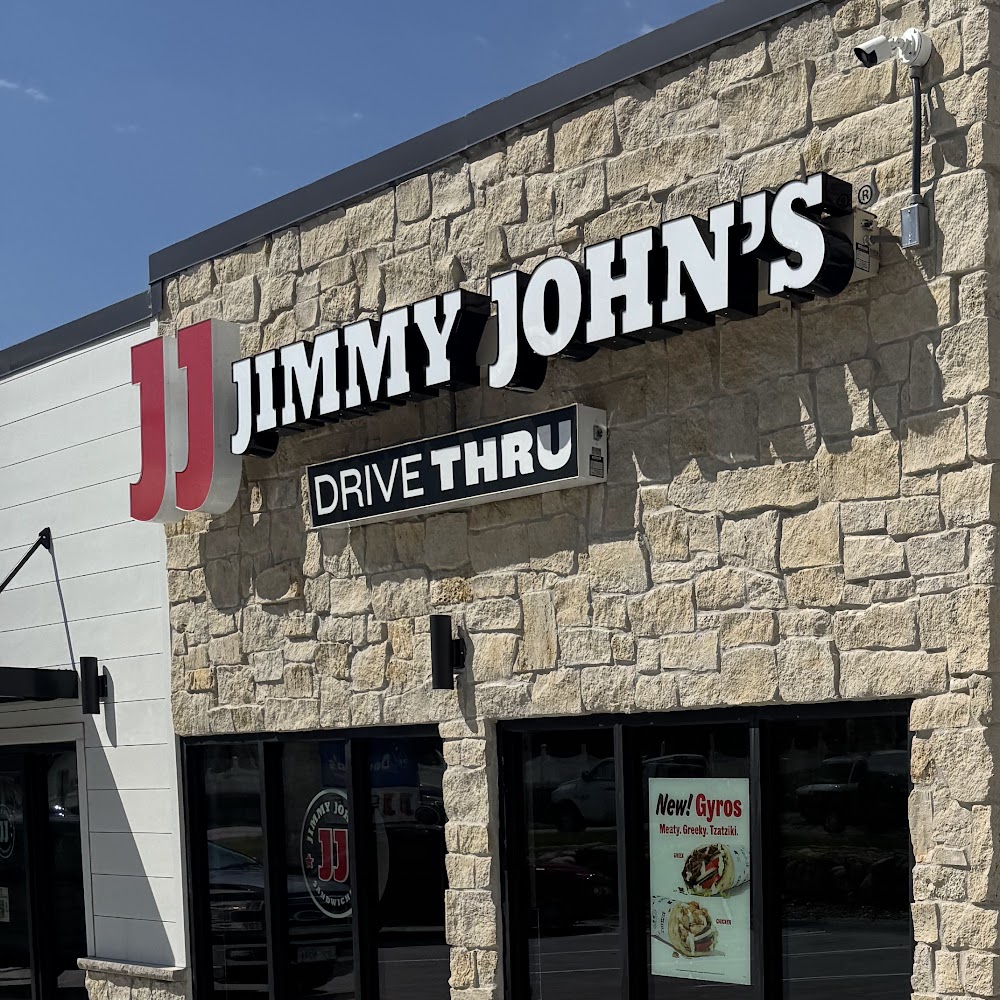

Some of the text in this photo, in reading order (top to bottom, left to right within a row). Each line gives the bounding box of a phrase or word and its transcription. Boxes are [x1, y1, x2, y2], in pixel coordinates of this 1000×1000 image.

[129, 317, 215, 523] JJ
[230, 288, 463, 456] JIMMY
[488, 170, 827, 390] JOHN'S
[313, 419, 572, 517] DRIVE THRU
[306, 801, 349, 845] JIMMY JOH
[655, 793, 742, 822] New! Gyros
[659, 824, 739, 838] Meaty. Greeky. Tzatziki.
[317, 827, 350, 883] JJ
[312, 880, 352, 907] SANDWICH
